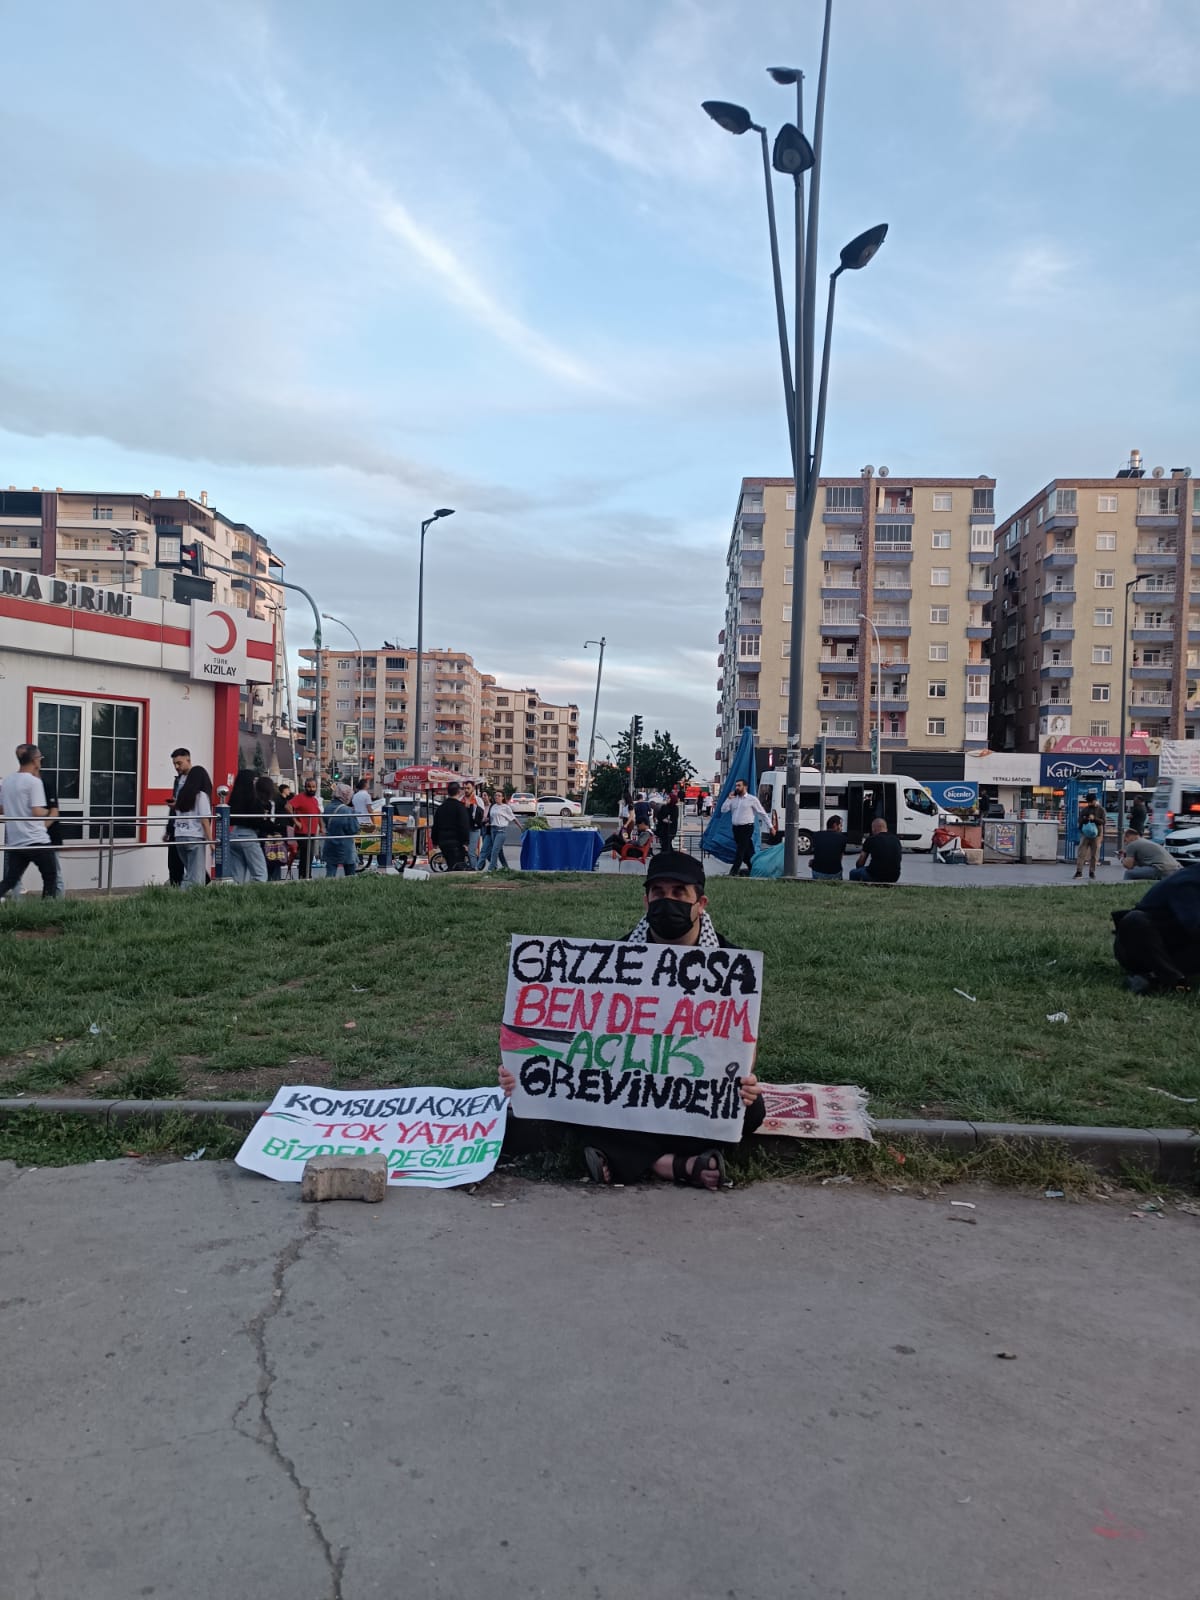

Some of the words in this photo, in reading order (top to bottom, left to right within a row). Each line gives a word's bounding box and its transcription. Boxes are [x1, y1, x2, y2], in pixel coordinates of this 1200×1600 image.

[203, 663, 237, 677] KIZILAY
[512, 939, 648, 985] GAZZE
[651, 947, 759, 996] AÇSA
[513, 984, 604, 1030] BEN
[606, 992, 660, 1035] DE
[663, 997, 756, 1043] AÇIM
[563, 1030, 704, 1077] AÇLIK
[415, 1094, 507, 1120] AÇKEN
[313, 1123, 388, 1141] TOK
[398, 1118, 498, 1144] YATAN
